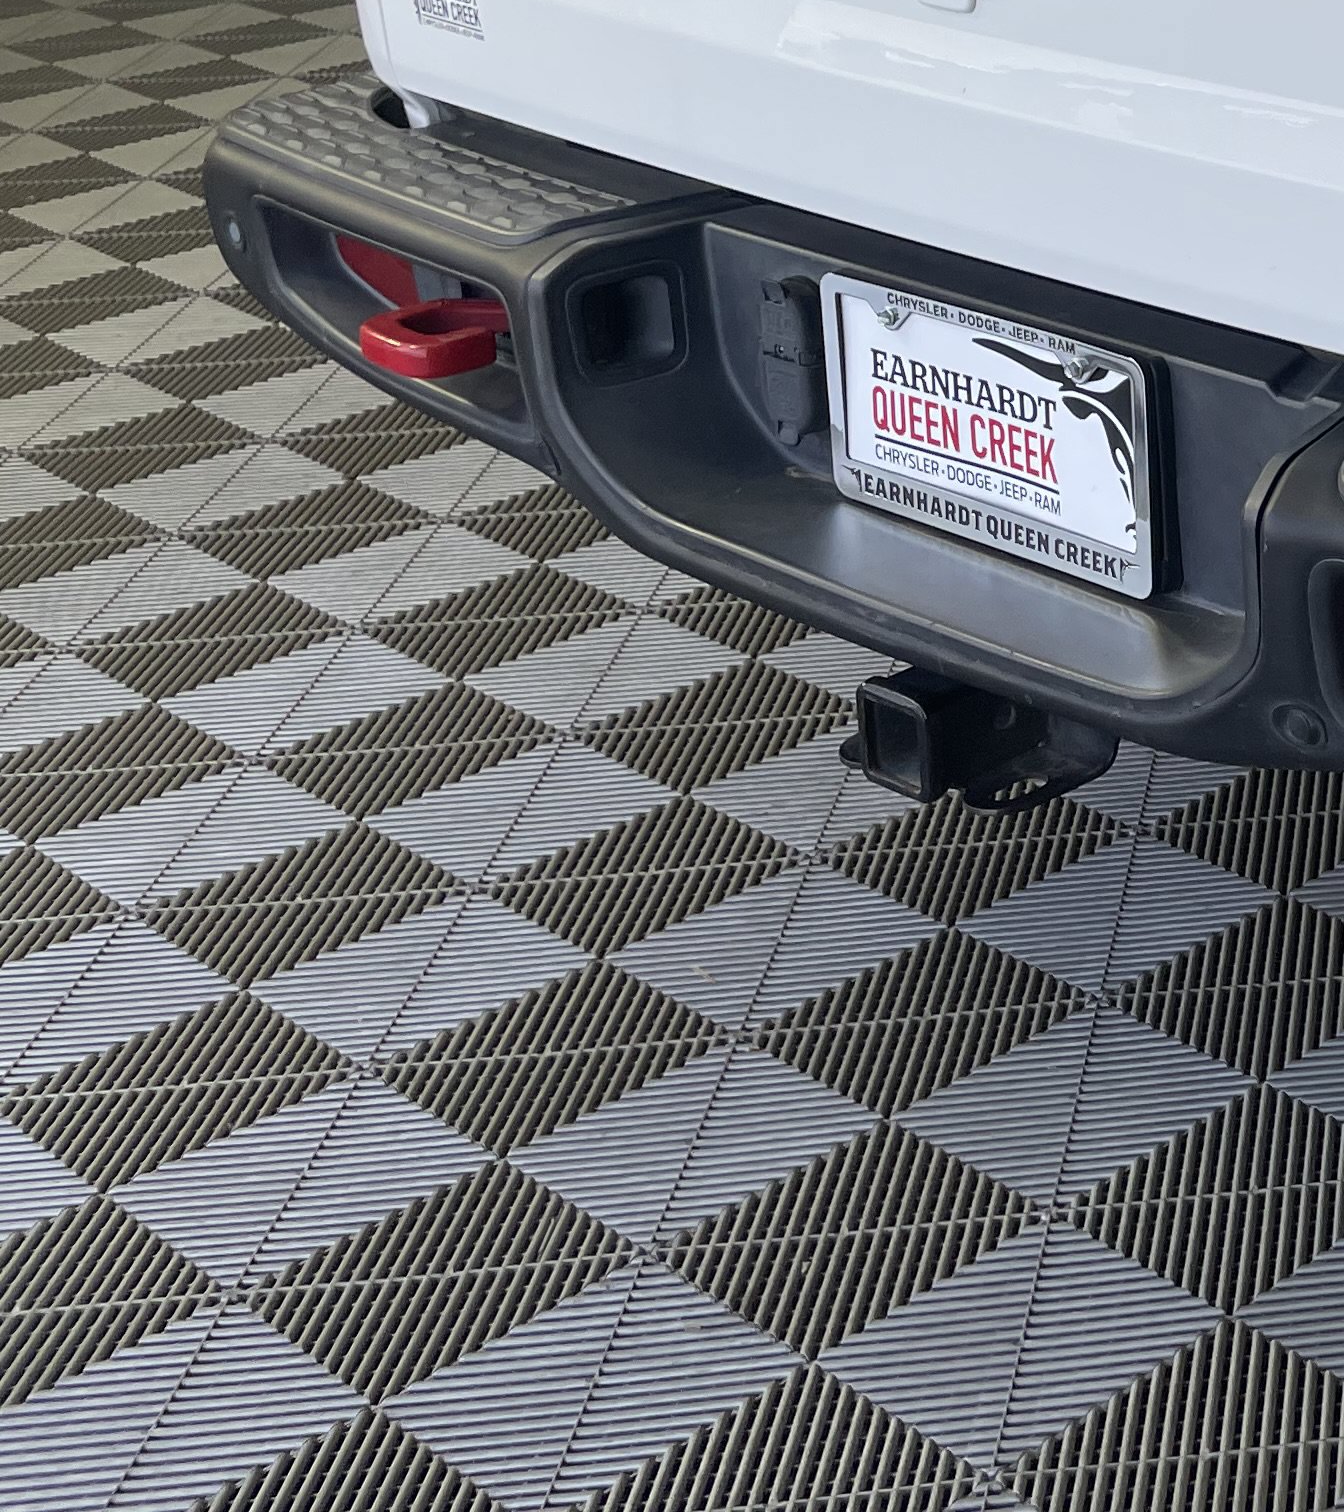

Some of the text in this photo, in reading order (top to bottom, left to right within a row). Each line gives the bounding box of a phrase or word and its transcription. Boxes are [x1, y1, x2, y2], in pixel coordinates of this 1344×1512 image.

[450, 2, 482, 28] CREEK
[1048, 337, 1077, 355] RAM
[870, 348, 1057, 430] EARNHARDT
[872, 385, 1058, 485] QUEEN CREEK
[864, 474, 1120, 579] EARNHARDT QUEEN CREEK
